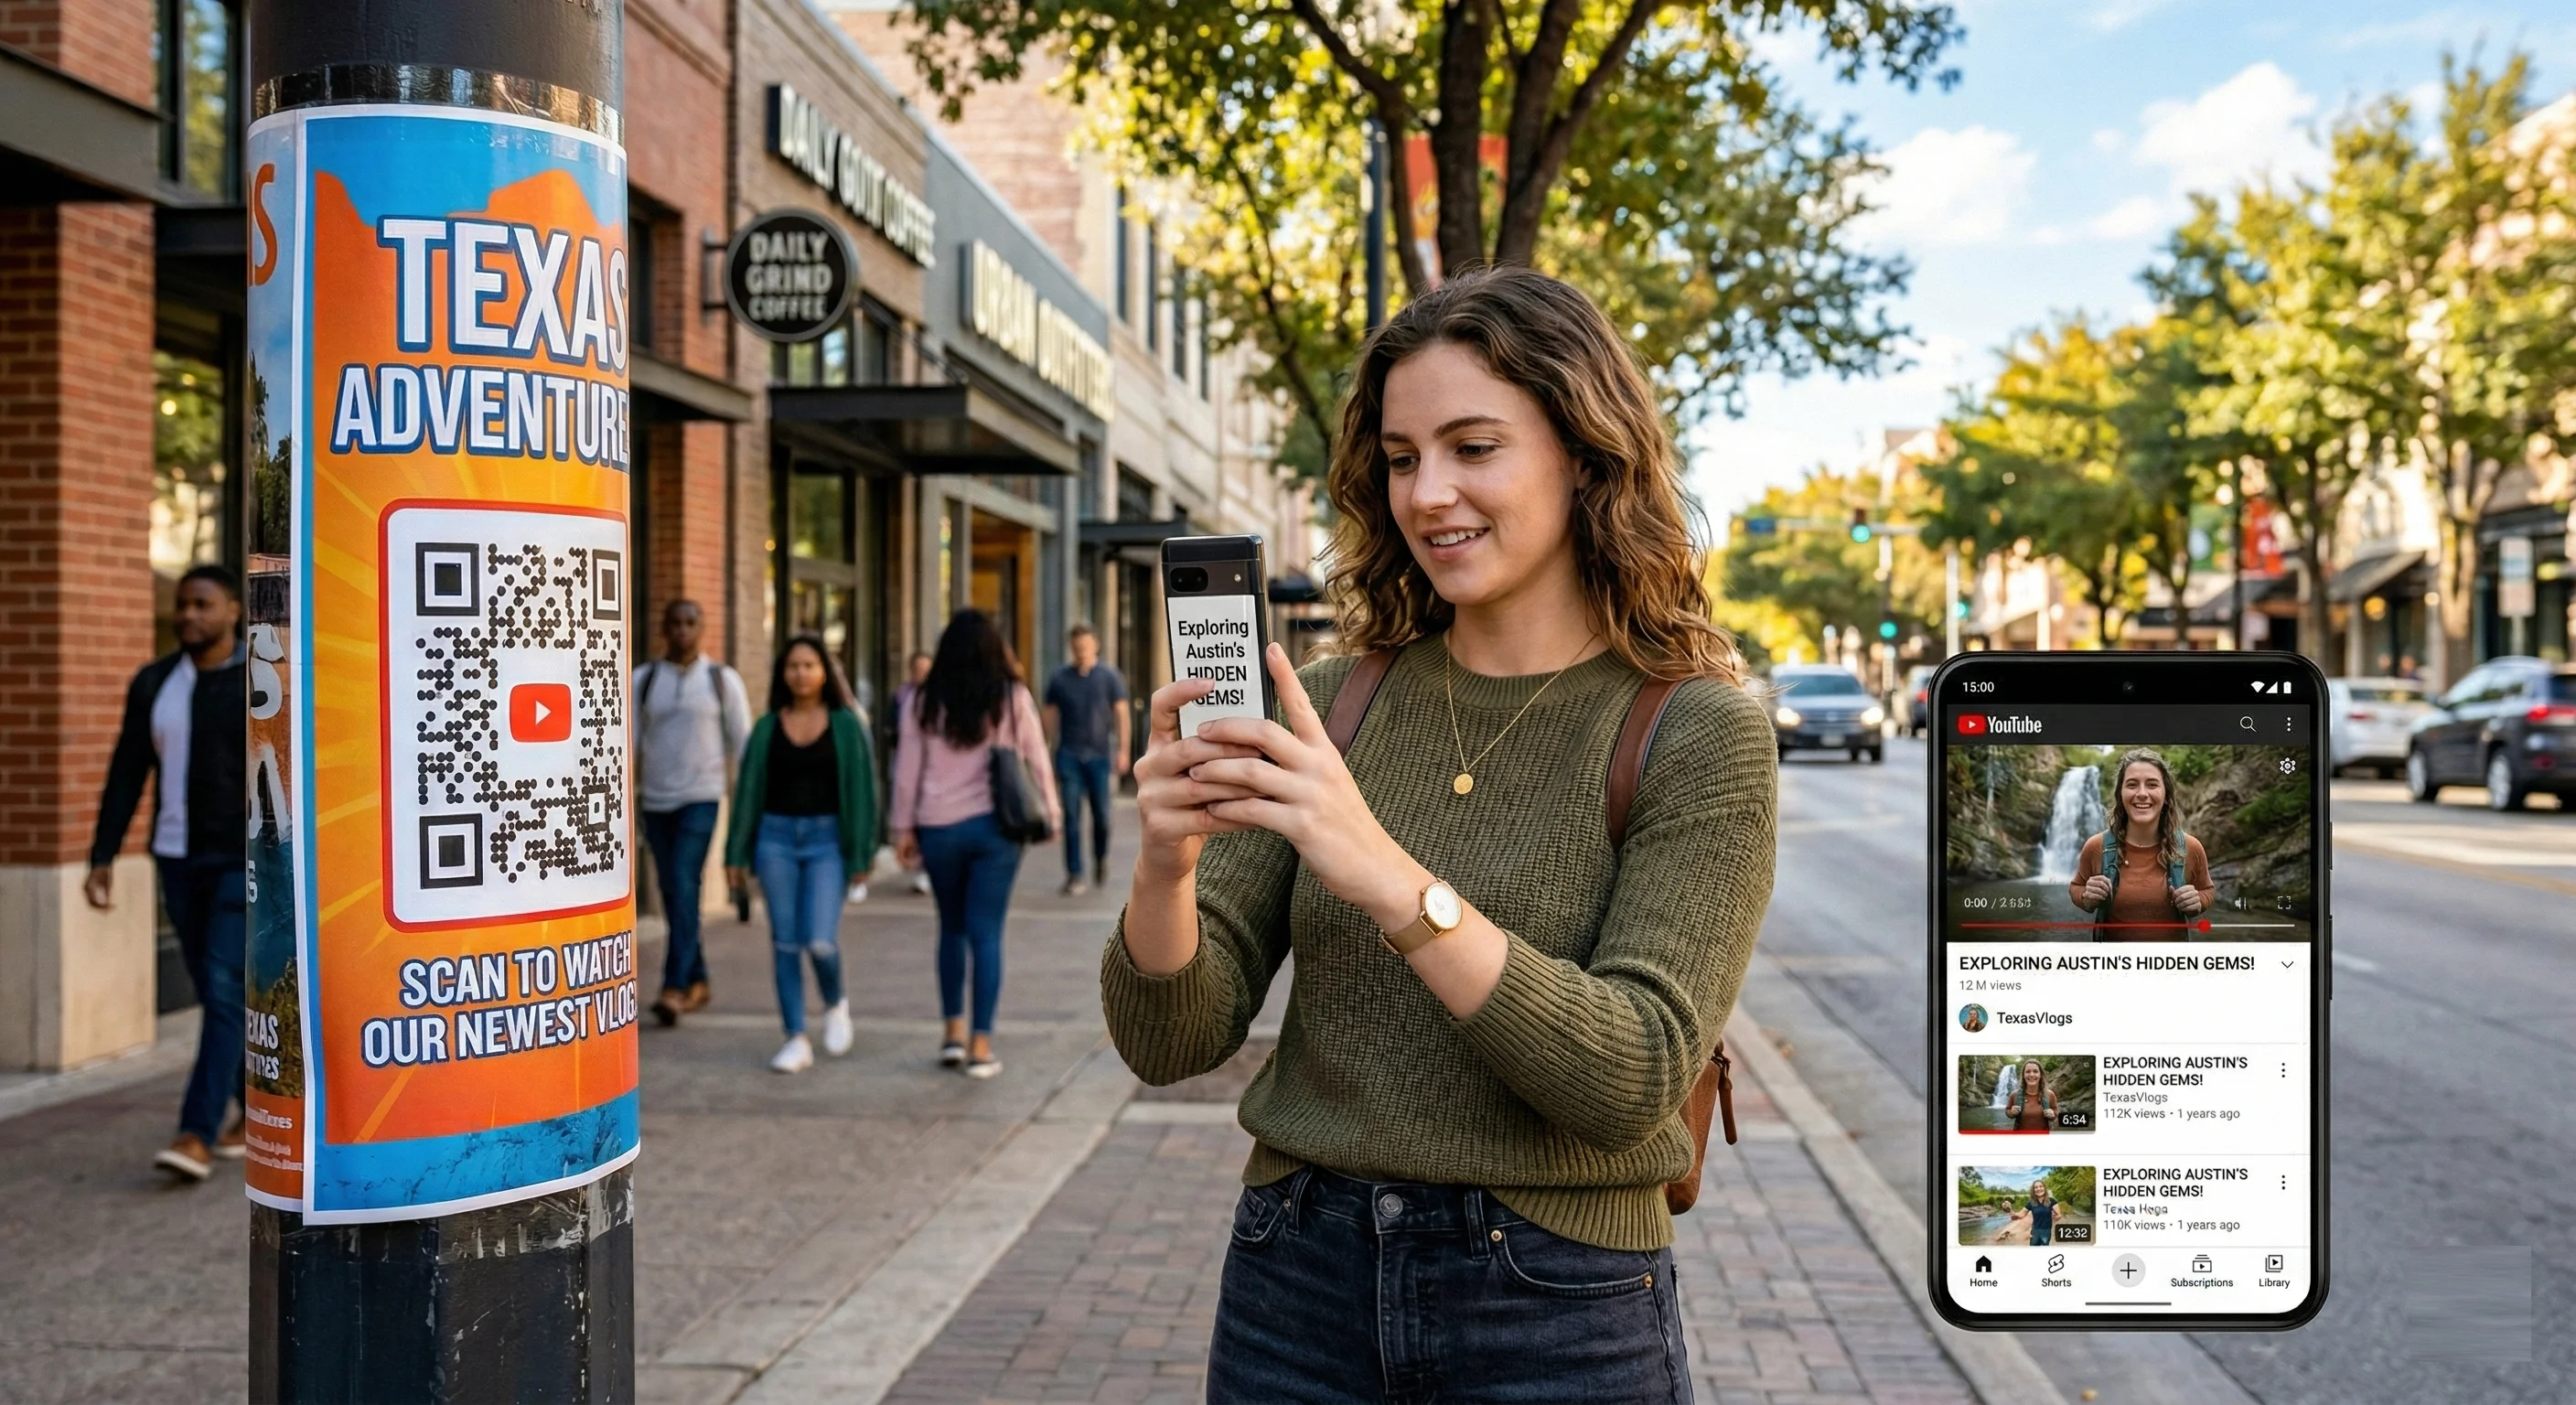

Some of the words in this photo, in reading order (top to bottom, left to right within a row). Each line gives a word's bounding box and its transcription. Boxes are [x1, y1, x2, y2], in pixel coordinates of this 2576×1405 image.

[748, 231, 829, 263] DAILY
[745, 263, 833, 296] GRIND
[380, 217, 628, 371] TEXAS
[333, 366, 630, 465] ADVENTURE
[1178, 618, 1249, 639] Exploring
[1186, 641, 1245, 660] Austin's
[1186, 665, 1247, 681] HIDDEN
[1962, 681, 1995, 692] 15:00
[1987, 715, 2043, 734] YouTube
[1964, 897, 1988, 908] 0:00
[401, 955, 506, 1006] SCAN
[514, 949, 557, 994] TO
[563, 932, 632, 989] WATCH
[1959, 956, 2053, 971] EXPLORING
[2056, 955, 2132, 971] AUSTIN'S
[2136, 956, 2198, 971] HIDDEN
[2203, 956, 2255, 971] GEMS!
[1990, 980, 2022, 991] views
[1996, 1012, 2073, 1026] TexasVlogs
[245, 1007, 279, 1050] EXAS
[362, 1016, 448, 1067] OUR
[456, 994, 591, 1057] NEWEST
[2103, 1056, 2182, 1069] EXPLORING
[2184, 1056, 2249, 1069] AUSTIN'S
[2103, 1074, 2156, 1086] HIDDEN
[2159, 1074, 2204, 1087] GEMS!
[2103, 1091, 2168, 1103] TexasVlogs
[2104, 1108, 2132, 1119] 112K
[2134, 1108, 2166, 1119] views
[2177, 1108, 2183, 1119] 1
[2186, 1110, 2216, 1121] years
[2219, 1110, 2240, 1121] ago
[2103, 1167, 2182, 1180] EXPLORING
[2184, 1167, 2249, 1180] AUSTIN'S
[2103, 1185, 2156, 1196] HIDDEN
[2159, 1185, 2204, 1197] GEMS!
[2103, 1218, 2132, 1230] 110K
[2177, 1219, 2183, 1230] 1
[2186, 1221, 2217, 1233] years
[2219, 1221, 2240, 1233] ago
[2058, 1227, 2088, 1239] 12:32
[1970, 1278, 1999, 1288] Home
[2041, 1278, 2072, 1288] Shorts
[2171, 1278, 2234, 1290] Subscriptions
[2259, 1278, 2291, 1290] Library
